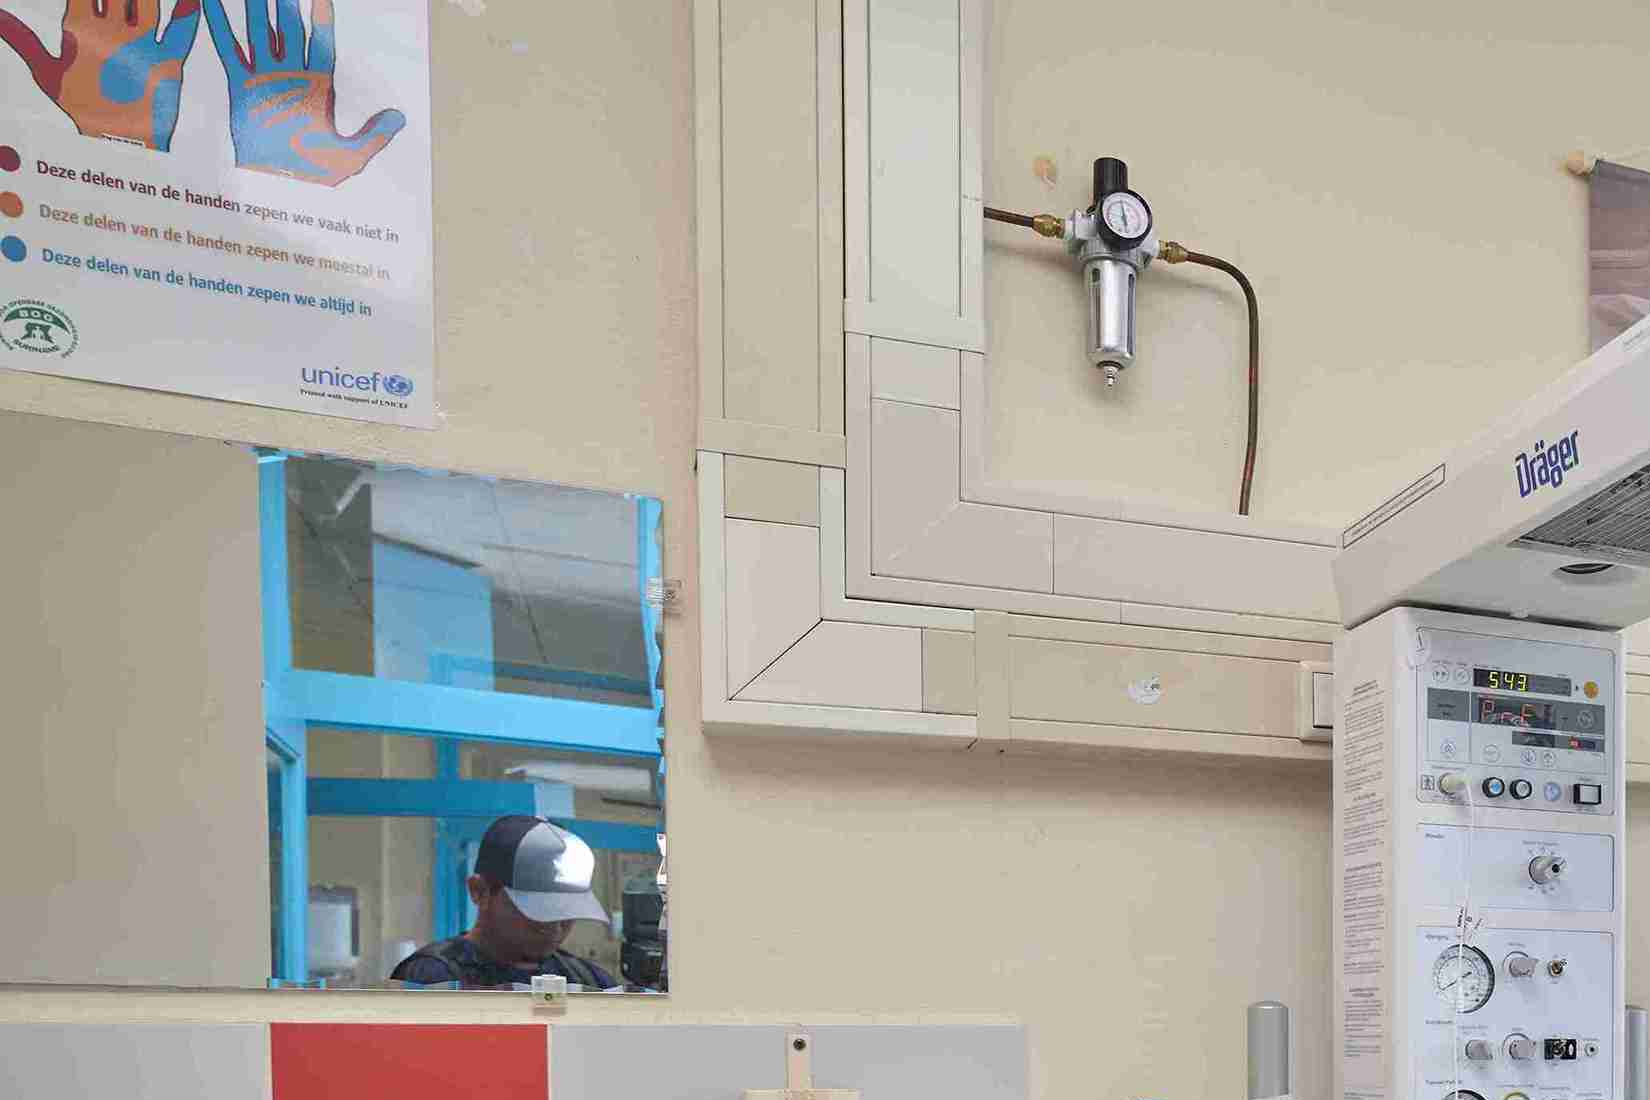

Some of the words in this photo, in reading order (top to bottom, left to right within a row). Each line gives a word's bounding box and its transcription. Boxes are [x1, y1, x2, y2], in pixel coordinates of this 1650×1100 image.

[37, 160, 76, 181] Deze
[81, 169, 124, 190] delen
[129, 181, 157, 196] van
[161, 185, 180, 201] de
[185, 189, 240, 213] handen
[244, 203, 288, 222] zepen
[293, 213, 314, 226] we
[318, 217, 351, 235] vaak
[356, 225, 382, 241] niet
[386, 228, 399, 243] in
[39, 204, 79, 224] Deze
[84, 213, 126, 233] delen
[131, 224, 159, 239] van
[163, 228, 182, 243] de
[187, 231, 241, 255] handen
[247, 244, 289, 262] zepen
[293, 253, 315, 266] we
[377, 268, 390, 281] in
[42, 248, 81, 268] Deze
[86, 256, 128, 276] delen
[133, 267, 160, 282] van
[166, 270, 184, 286] de
[189, 273, 243, 296] handen
[247, 285, 290, 304] zepen
[294, 294, 316, 307] we
[320, 297, 355, 316] altijd
[359, 301, 372, 317] in
[302, 367, 381, 392] unicef
[1515, 430, 1579, 498] Dräger
